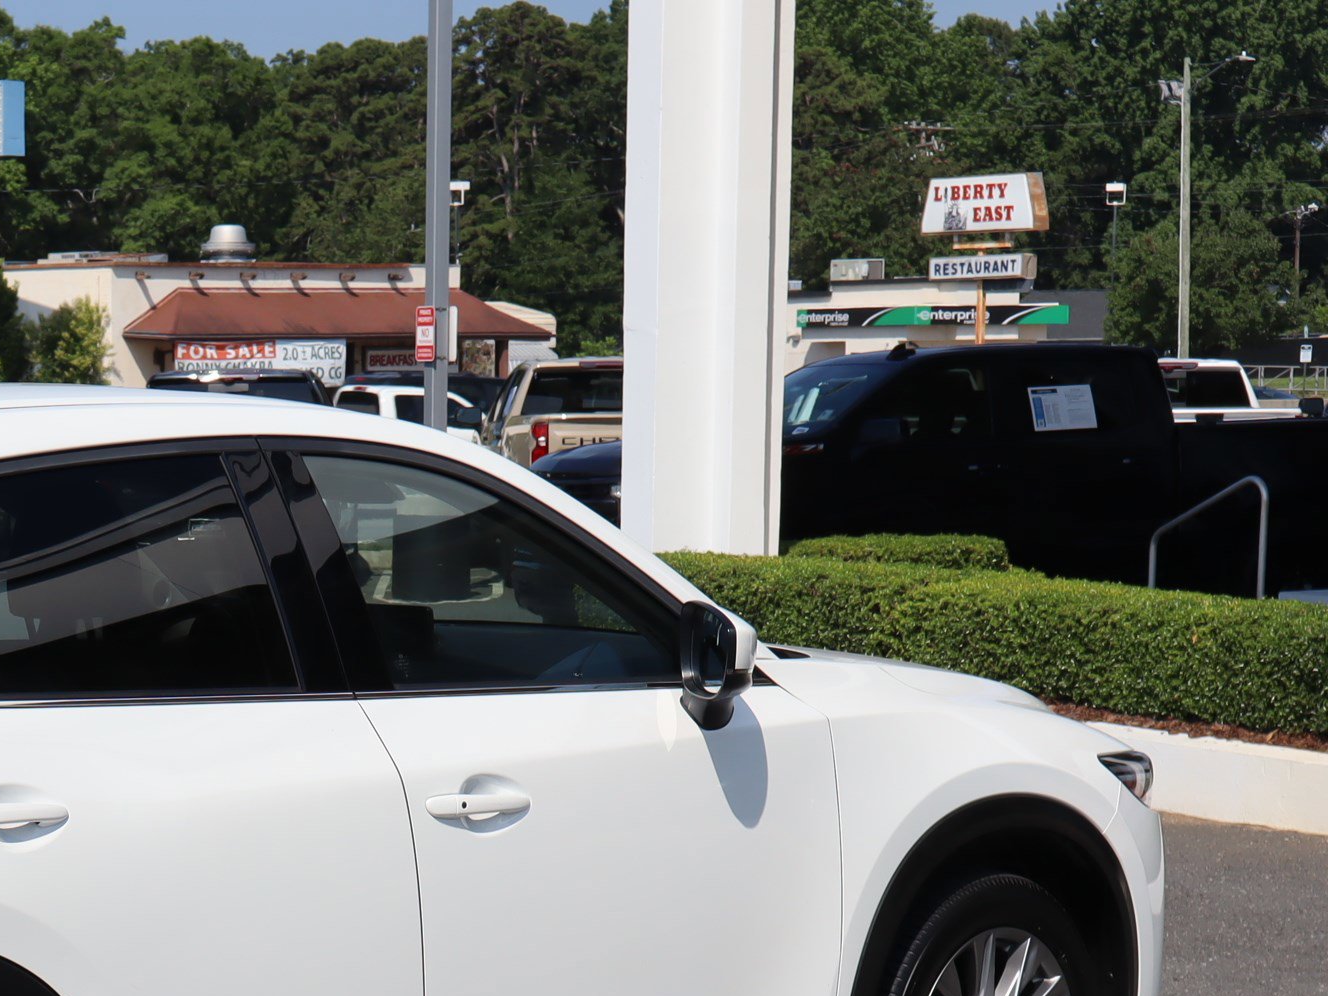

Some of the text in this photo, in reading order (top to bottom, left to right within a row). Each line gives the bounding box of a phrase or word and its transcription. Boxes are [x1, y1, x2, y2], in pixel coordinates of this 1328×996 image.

[934, 183, 1007, 202] LIBERTY
[973, 205, 1014, 222] EAST
[934, 260, 1016, 276] RESTAURANT
[798, 311, 849, 325] enterprise
[917, 309, 990, 323] enterprie
[176, 342, 275, 359] FOR SALE
[282, 347, 299, 361] 2.0
[311, 345, 342, 361] ACRES
[328, 366, 342, 380] CG
